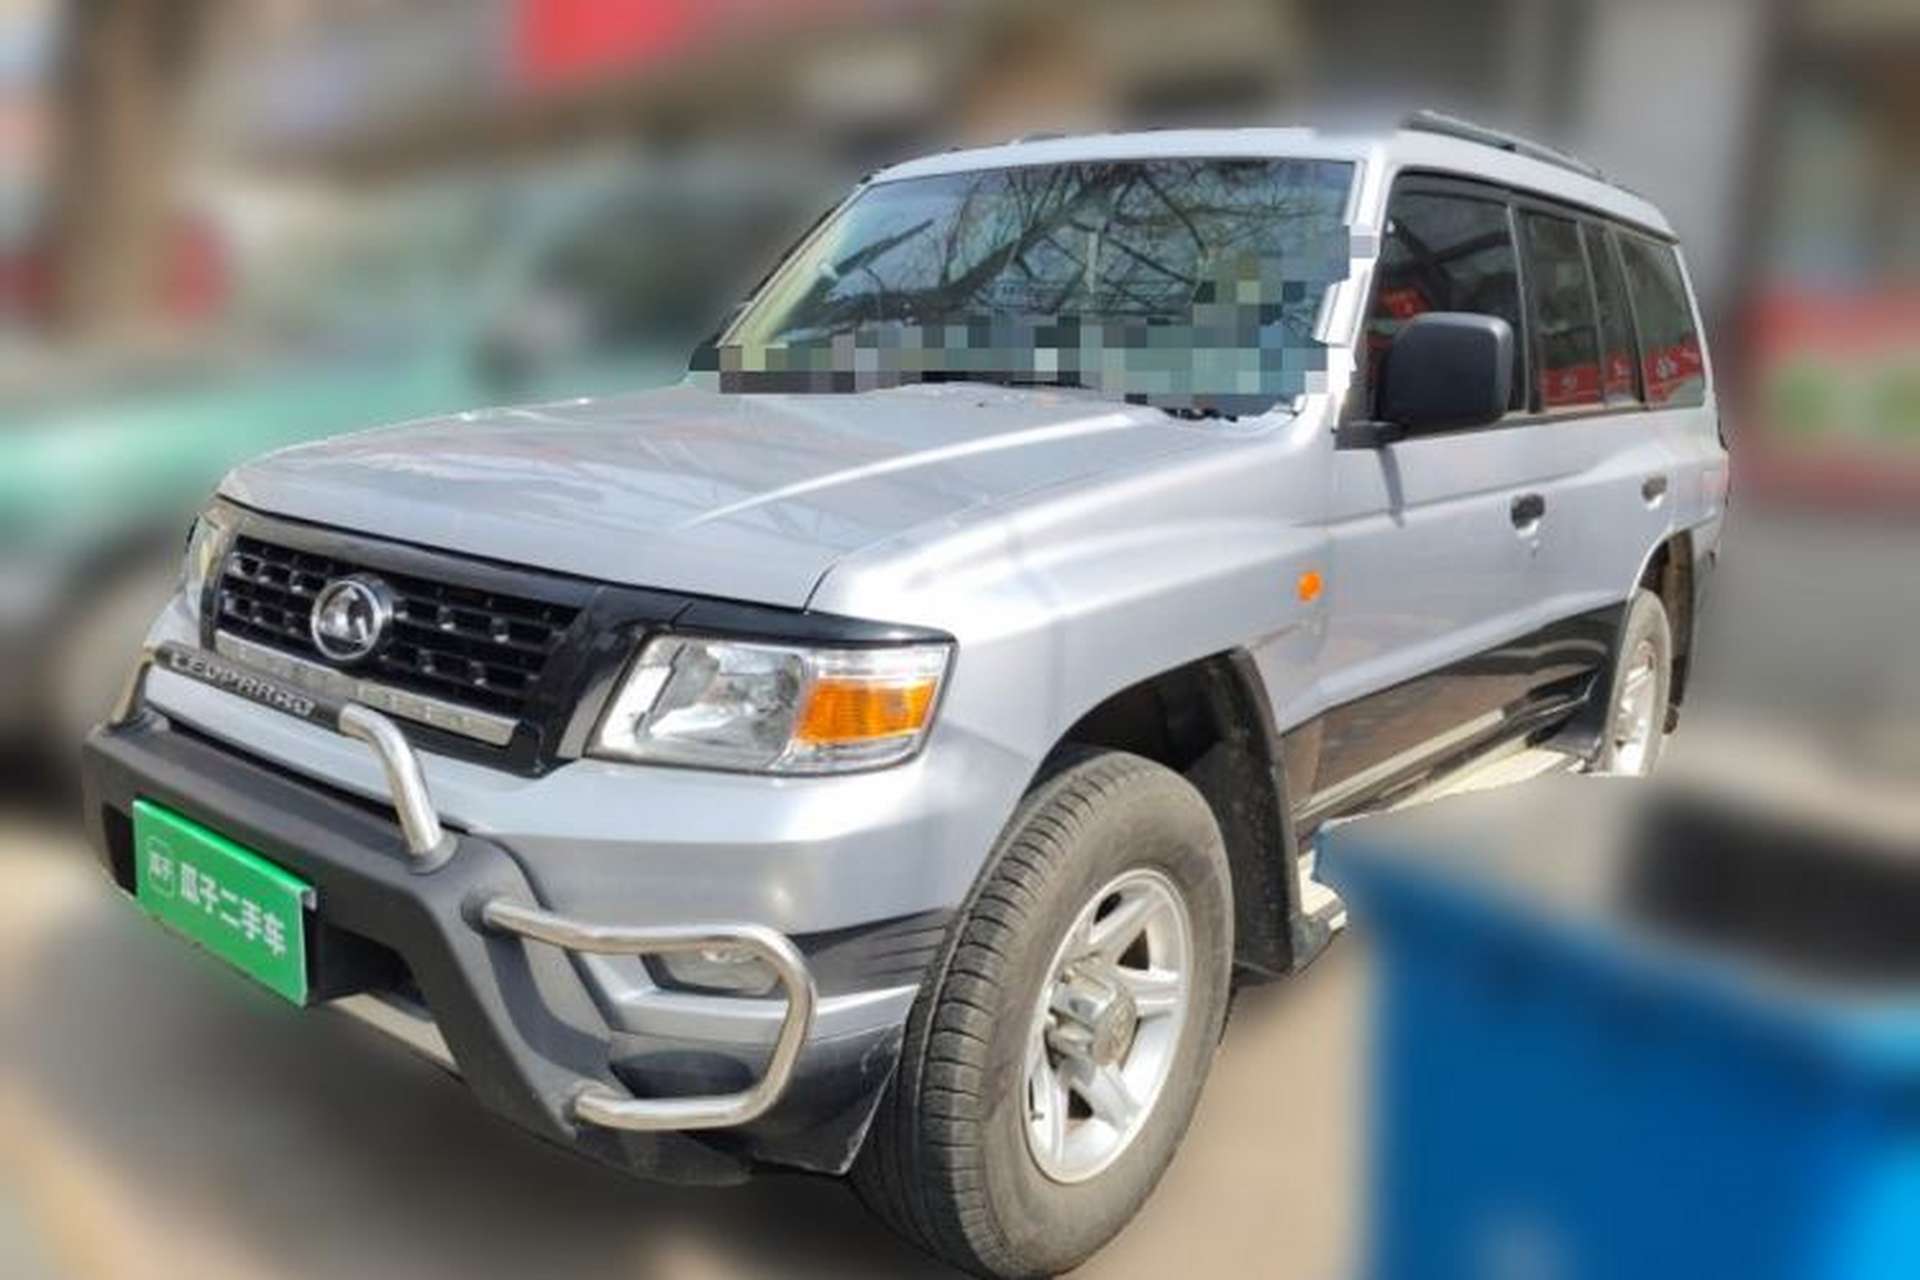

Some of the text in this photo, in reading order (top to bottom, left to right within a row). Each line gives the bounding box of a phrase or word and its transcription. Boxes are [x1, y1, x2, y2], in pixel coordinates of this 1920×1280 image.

[180, 861, 287, 957] 瓜子二手车
